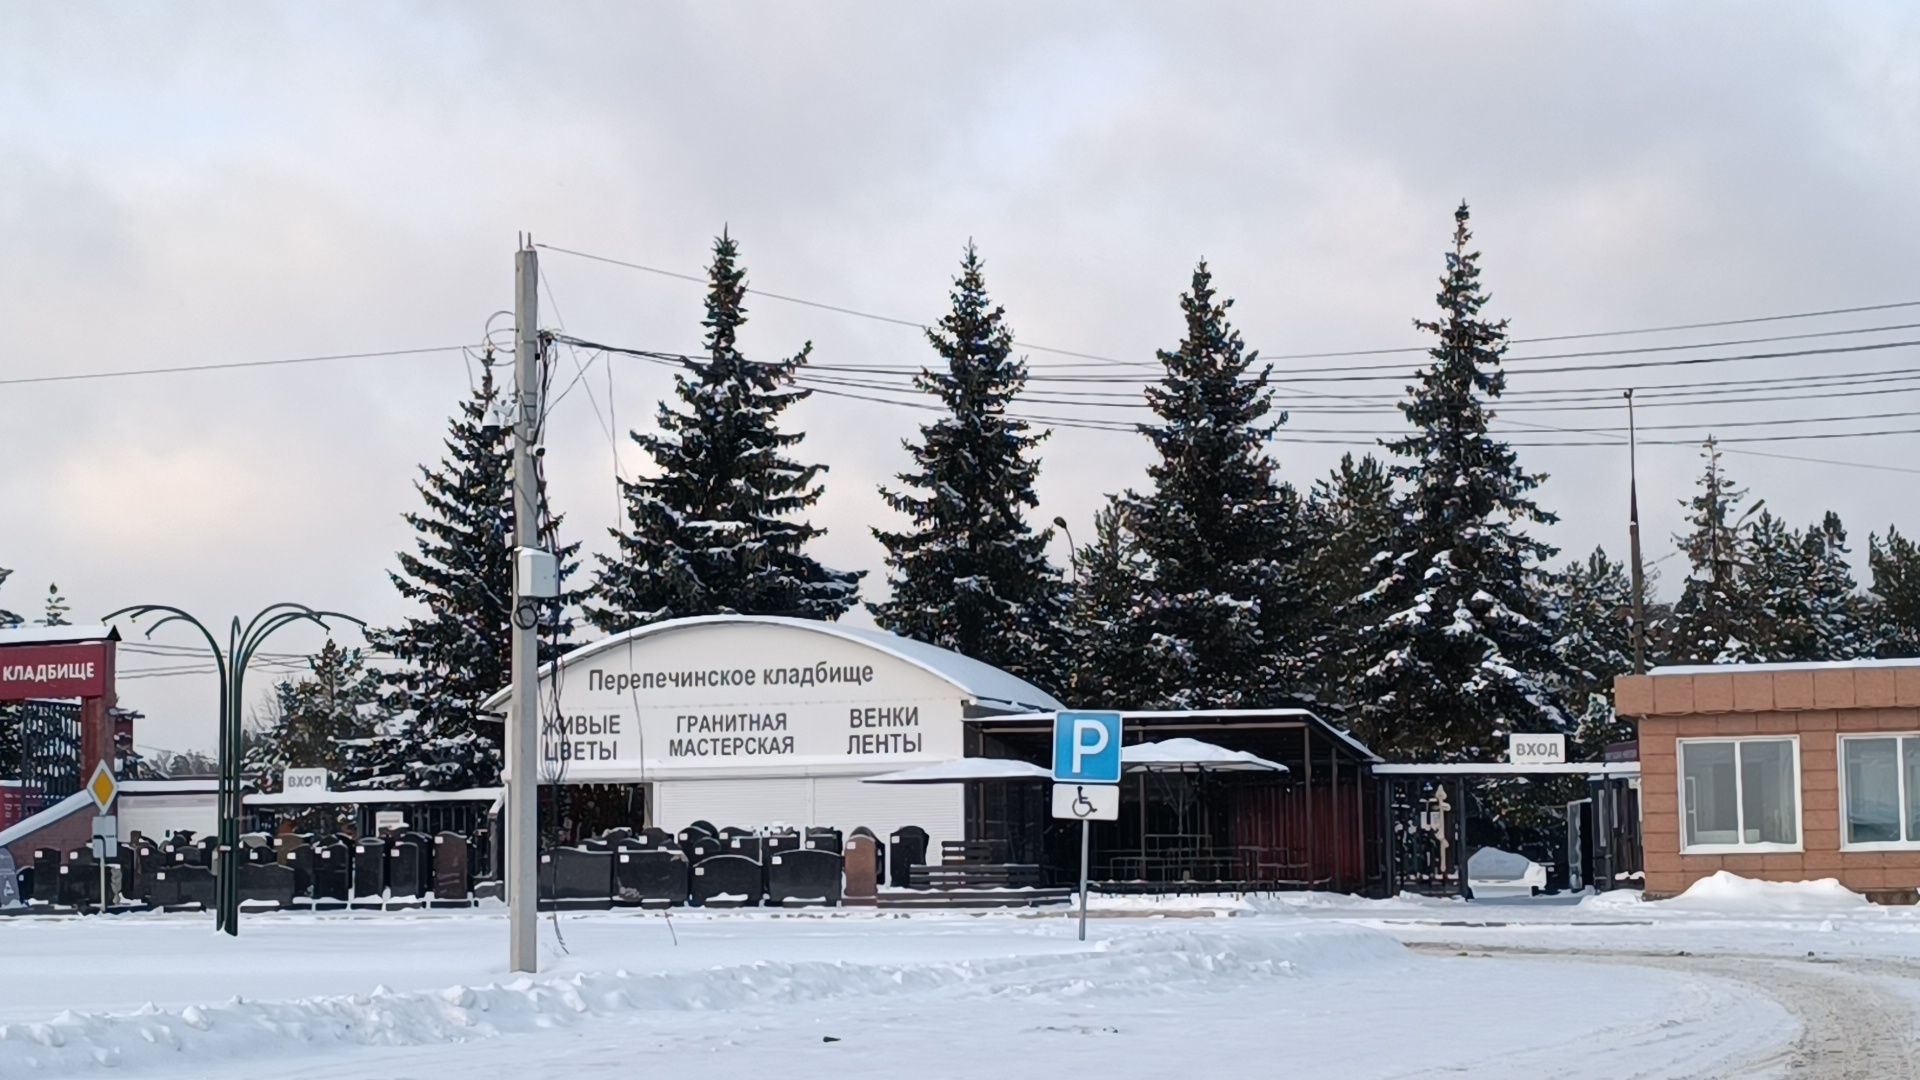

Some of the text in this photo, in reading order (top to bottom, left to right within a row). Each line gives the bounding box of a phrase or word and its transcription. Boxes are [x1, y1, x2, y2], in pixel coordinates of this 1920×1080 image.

[3, 662, 95, 682] КЛАДБИЩЕ
[589, 661, 874, 695] Перепечинское кладбище
[676, 712, 787, 733] ГРАНИТНАЯ
[850, 707, 919, 729] ВЕНКИ
[545, 741, 617, 761] ЦВЕТЫ
[669, 736, 794, 757] МАСТЕРСКАЯ
[847, 733, 922, 755] ЛЕНТЫ
[1516, 743, 1559, 757] ВХОД
